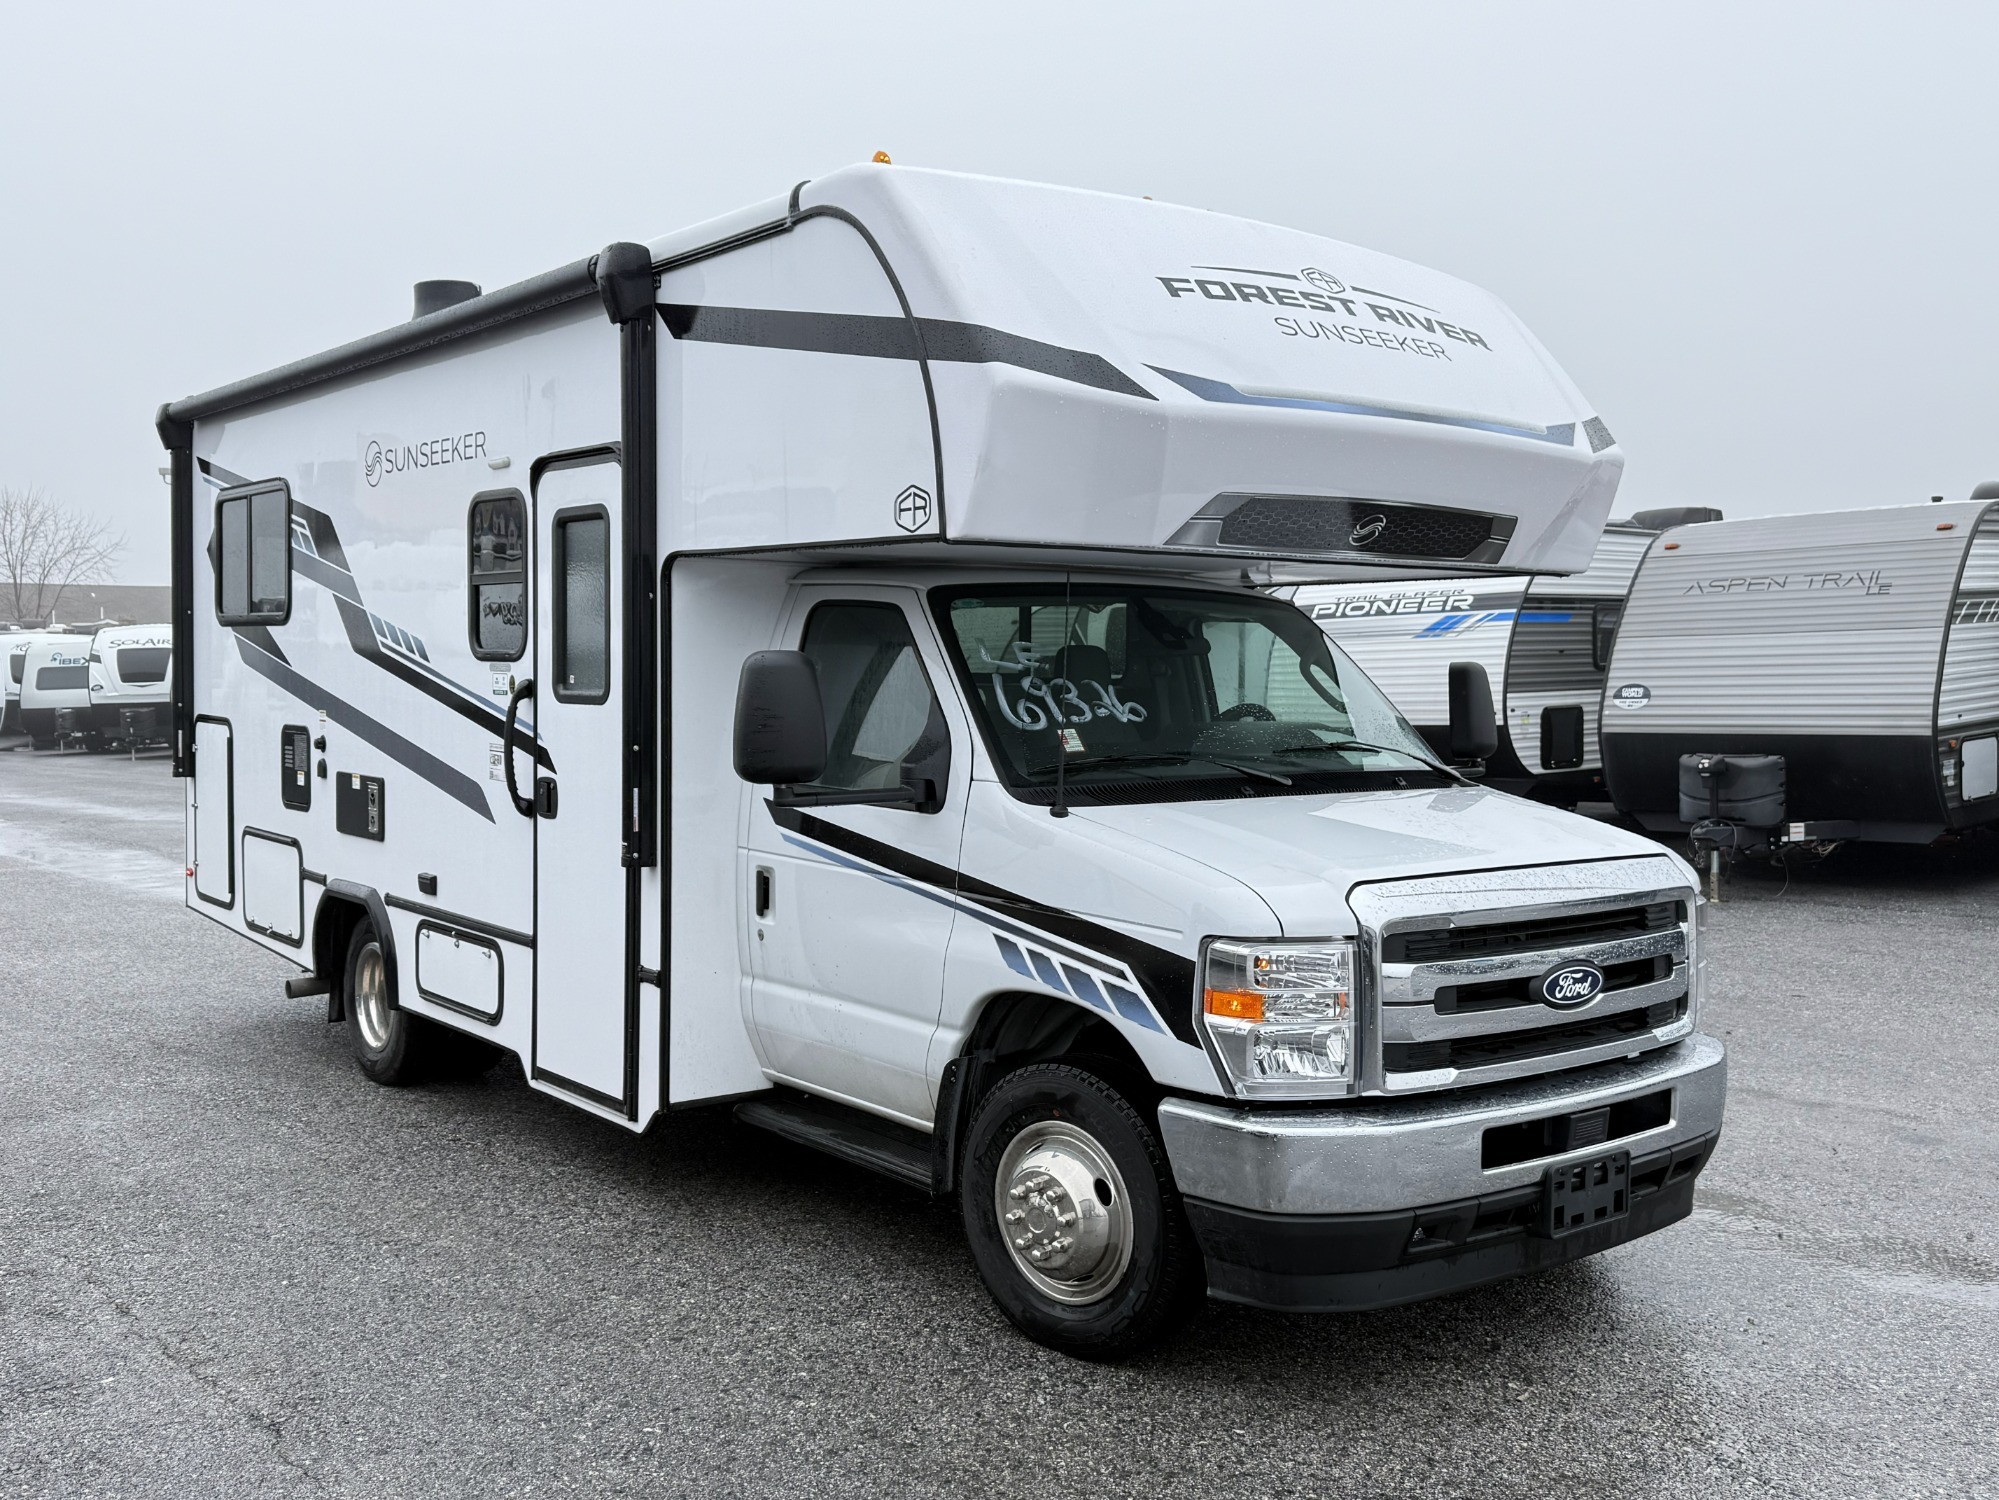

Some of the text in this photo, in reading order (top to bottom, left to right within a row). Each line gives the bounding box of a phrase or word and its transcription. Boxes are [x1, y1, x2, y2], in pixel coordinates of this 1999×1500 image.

[1155, 275, 1494, 353] FOREST RIVER
[1273, 316, 1453, 362] SUNSEEKER
[384, 431, 487, 474] SUNSEEKER
[1683, 569, 1893, 595] ASPEN TRAIL
[1865, 584, 1893, 596] LE
[1310, 594, 1475, 620] PIONEER
[1335, 588, 1465, 603] TRAIL BLAZER
[58, 656, 89, 666] IBEX
[1555, 972, 1592, 999] Ford
